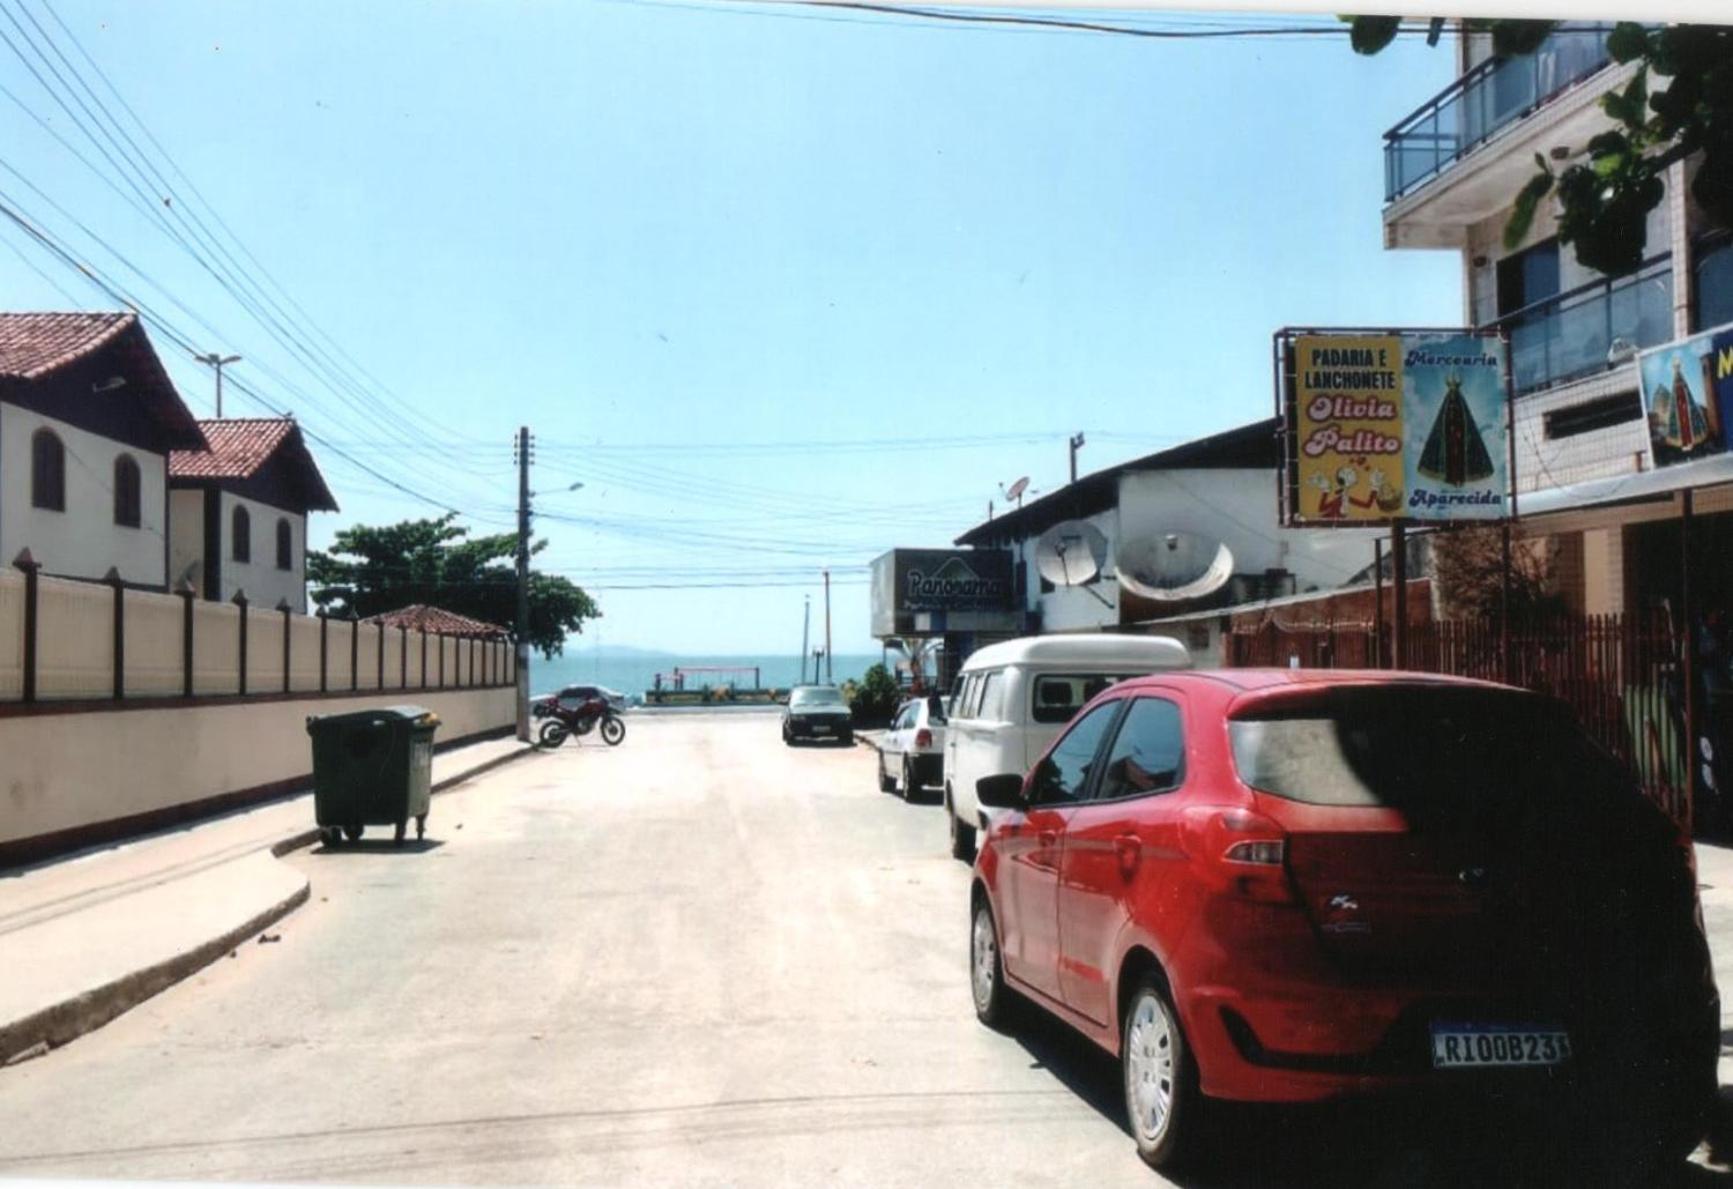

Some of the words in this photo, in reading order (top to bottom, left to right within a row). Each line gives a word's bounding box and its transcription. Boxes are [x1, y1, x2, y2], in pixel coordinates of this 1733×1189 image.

[1312, 348, 1374, 367] PADARIA
[1379, 348, 1387, 367] E
[1405, 350, 1498, 367] Mercearia
[1305, 371, 1396, 390] LANCHONETE
[1308, 395, 1398, 421] Olivia
[1304, 424, 1400, 455] Palito
[1408, 488, 1502, 508] Aparecida
